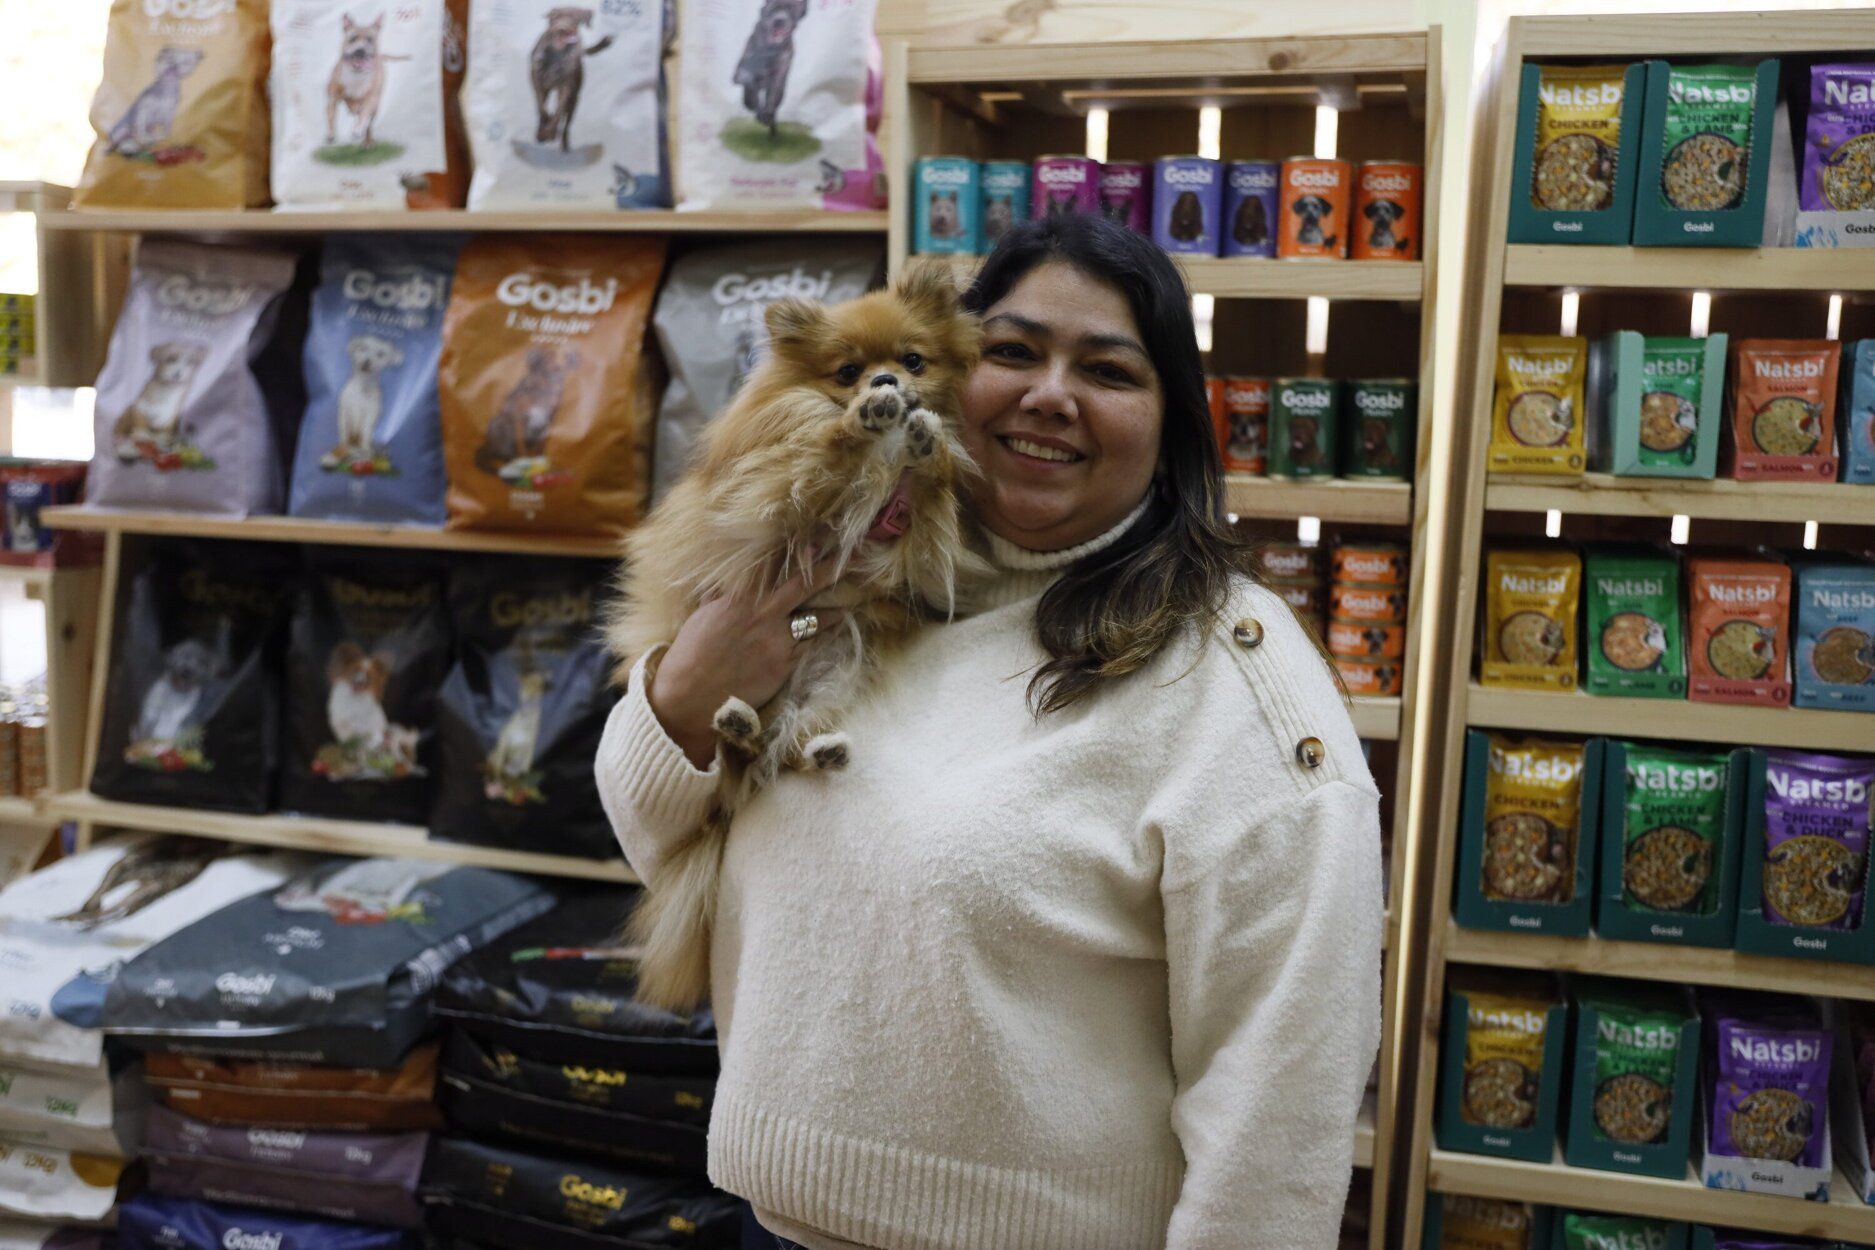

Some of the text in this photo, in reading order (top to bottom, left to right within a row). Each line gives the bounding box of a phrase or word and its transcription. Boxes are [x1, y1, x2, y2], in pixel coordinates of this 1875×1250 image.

[1539, 82, 1622, 106] Natsb
[1549, 119, 1608, 129] CHICKEN
[1039, 165, 1086, 184] Gosbi
[1163, 165, 1213, 185] Gosbi
[1290, 168, 1339, 187] Gosbi
[1362, 174, 1411, 191] Gosbi
[343, 269, 446, 310] Gosbi
[496, 273, 618, 315] Gosbi
[711, 268, 833, 306] Gosbi
[1643, 357, 1696, 376] atsbi
[1755, 359, 1825, 378] Natsbi
[1281, 389, 1331, 408] Gosbi
[1355, 391, 1405, 409] Gosbi
[1501, 574, 1567, 594] Natsbi
[1599, 578, 1664, 597] Natsbi
[1708, 583, 1778, 603] Natsbi
[1766, 768, 1867, 804] Natsb
[1782, 811, 1854, 827] CHICKEN
[1597, 1019, 1683, 1050] Natsb
[1731, 1036, 1820, 1063] Natsbi
